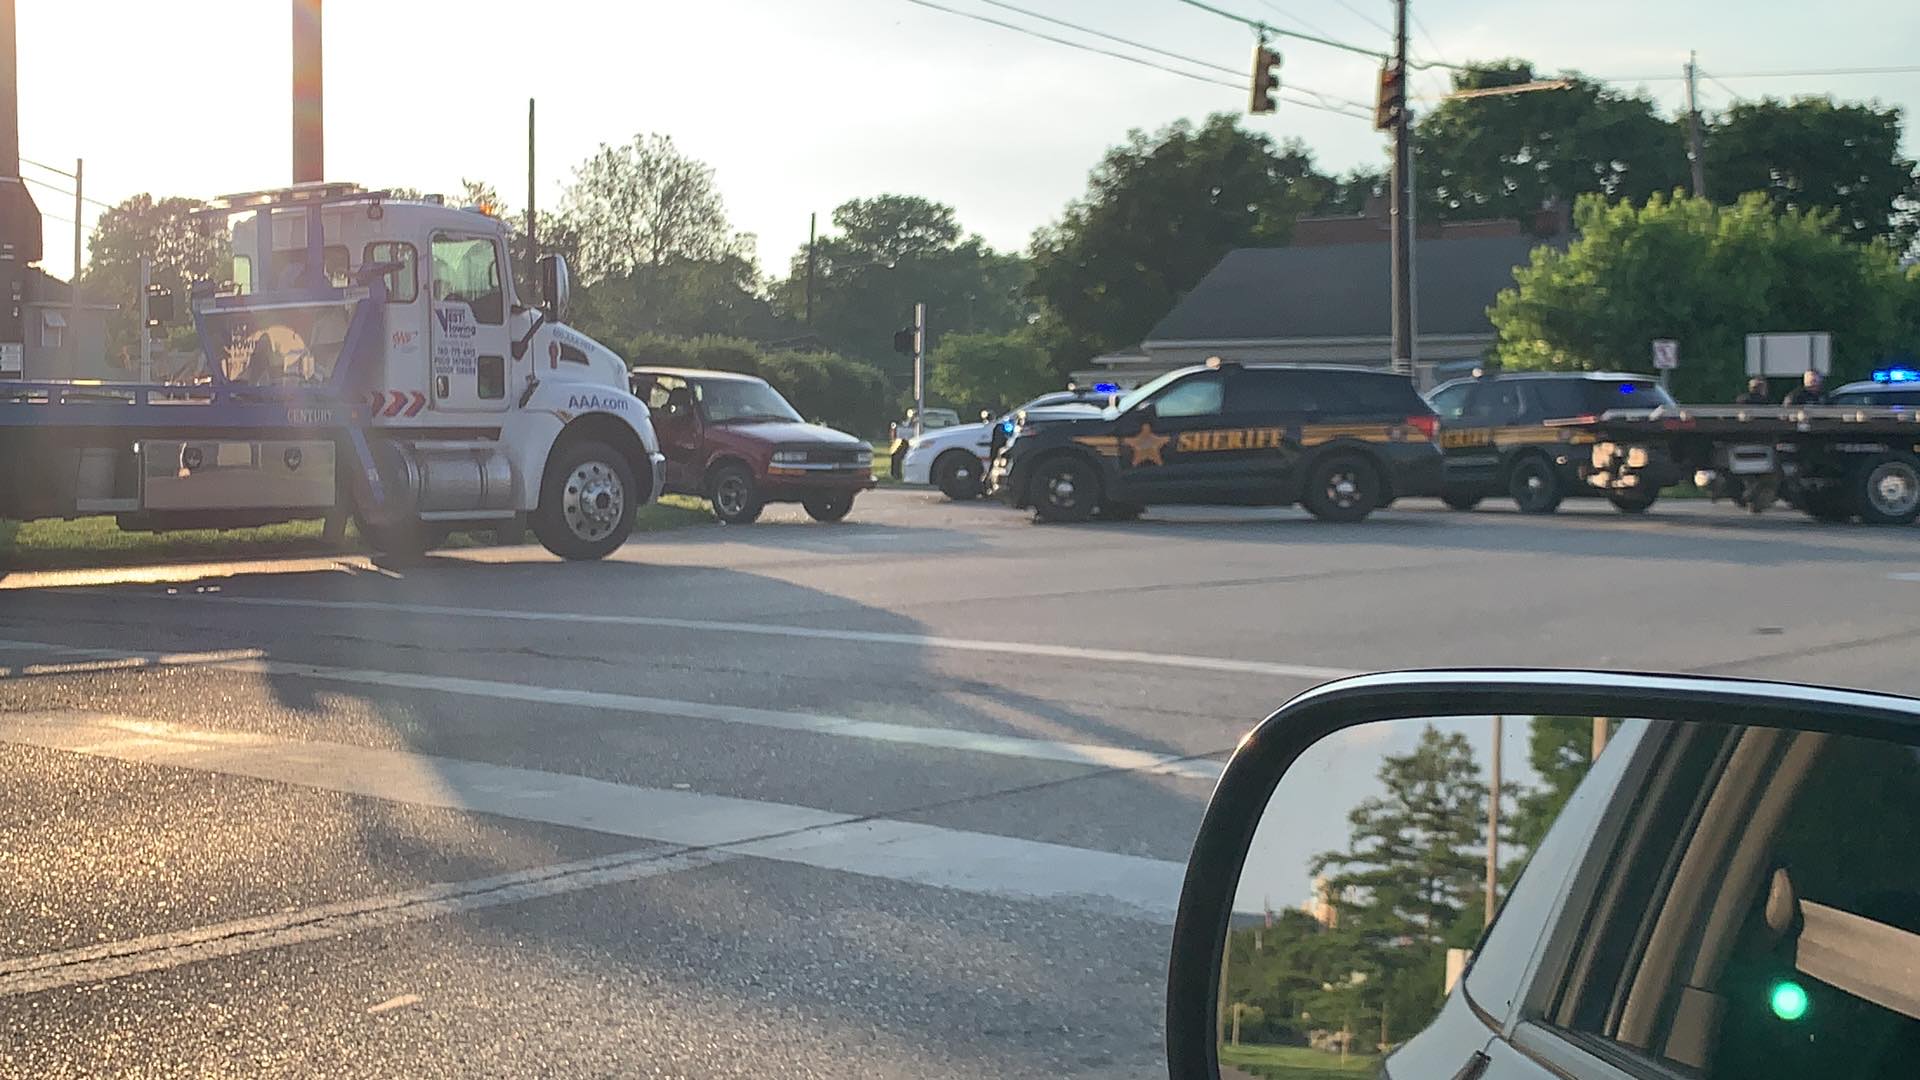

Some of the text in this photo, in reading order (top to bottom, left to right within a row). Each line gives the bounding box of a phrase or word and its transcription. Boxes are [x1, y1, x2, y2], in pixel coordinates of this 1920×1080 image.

[568, 394, 629, 411] AAA.com
[287, 408, 332, 423] CENTURY
[1177, 427, 1285, 453] SHERIFF
